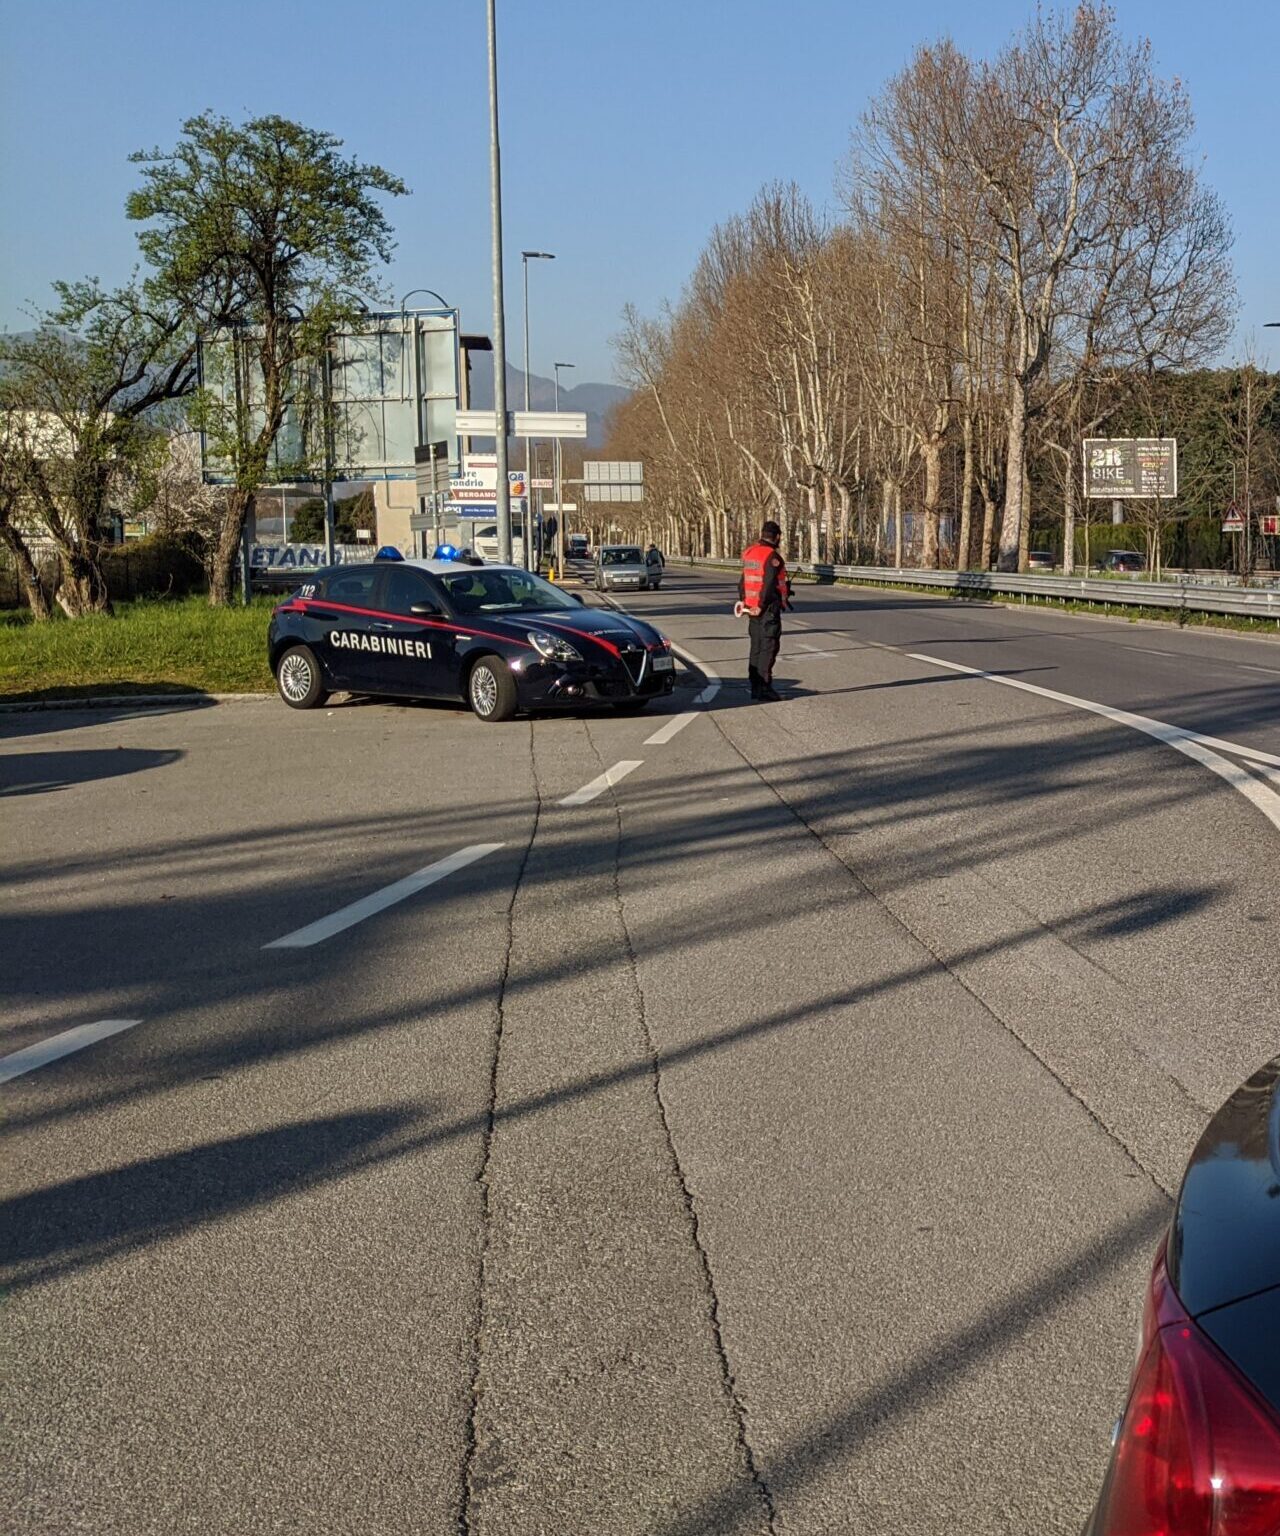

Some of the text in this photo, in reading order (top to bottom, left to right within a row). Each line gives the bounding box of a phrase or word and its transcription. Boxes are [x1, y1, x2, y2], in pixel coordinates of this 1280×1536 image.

[509, 472, 524, 481] Q8
[1093, 467, 1124, 479] BIKE
[301, 584, 316, 597] 112
[330, 630, 433, 660] CARABINIERI
